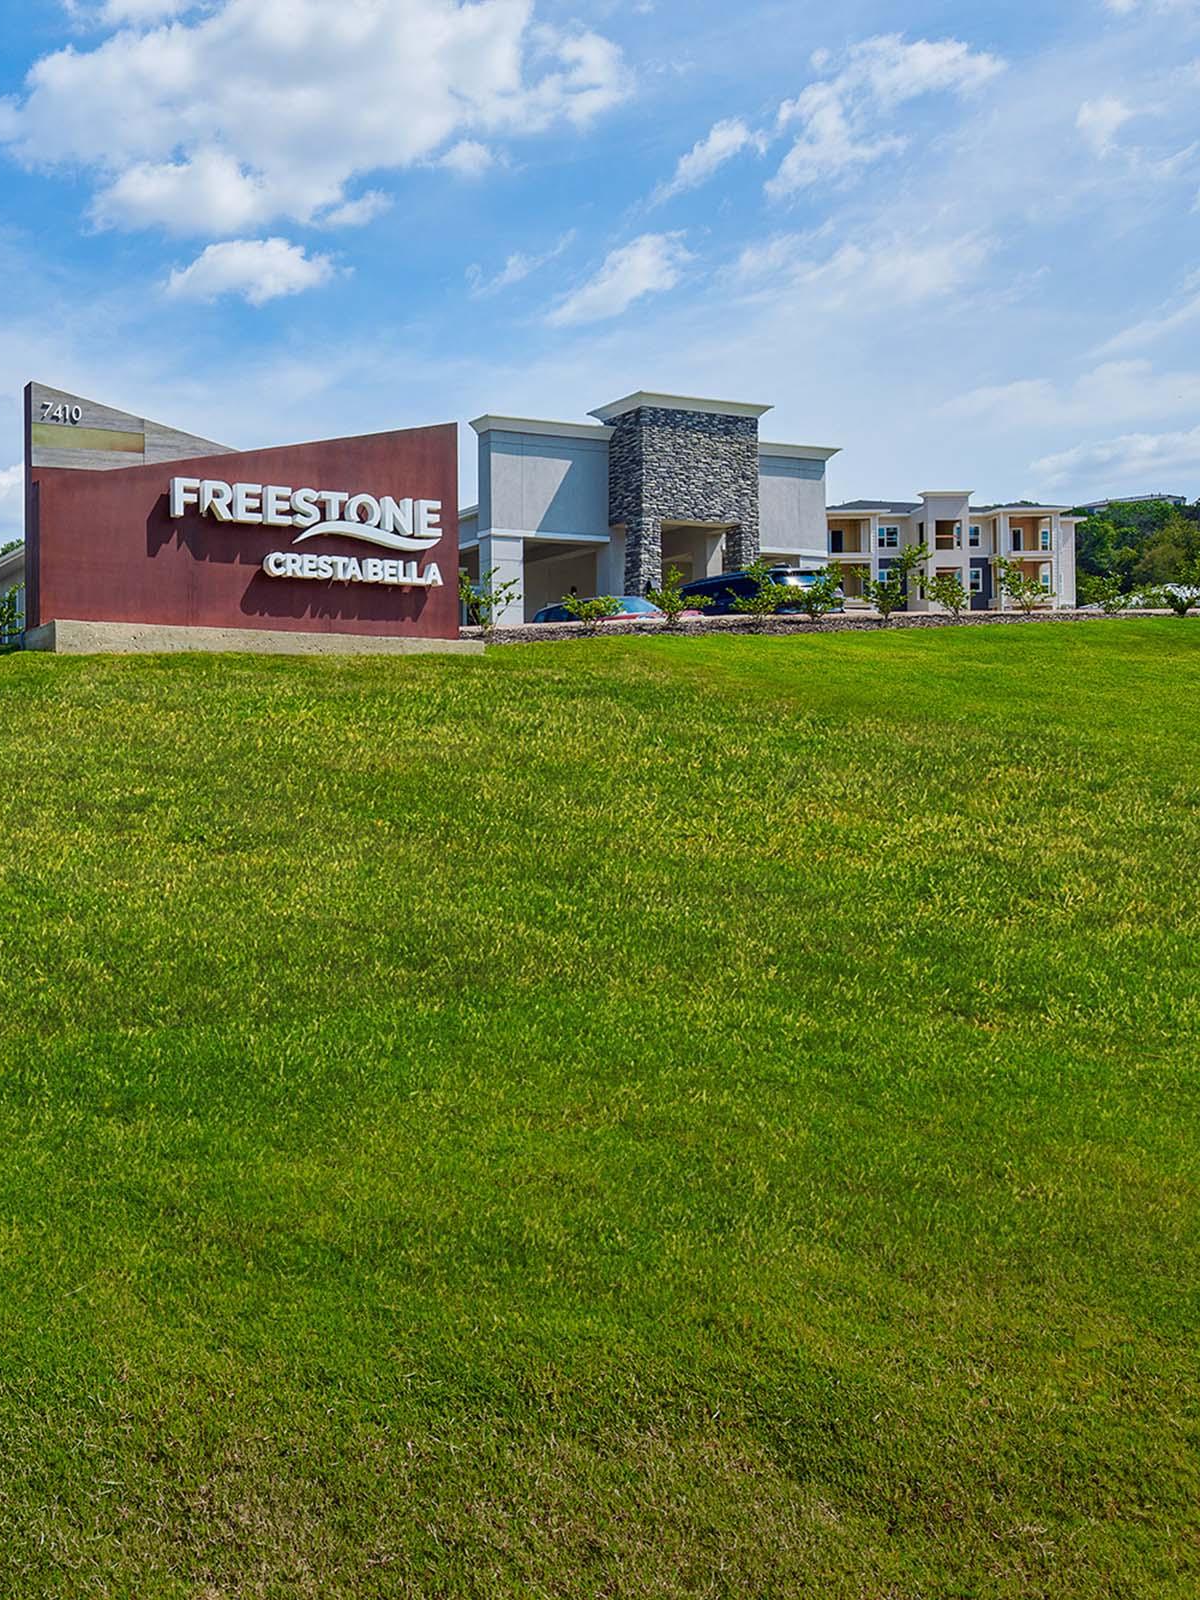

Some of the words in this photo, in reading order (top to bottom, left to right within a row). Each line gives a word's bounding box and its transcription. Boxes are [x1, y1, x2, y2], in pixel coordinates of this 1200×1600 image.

[42, 401, 82, 421] 7410
[170, 476, 443, 538] FREESTONE
[263, 551, 444, 586] CRESTABELLA
